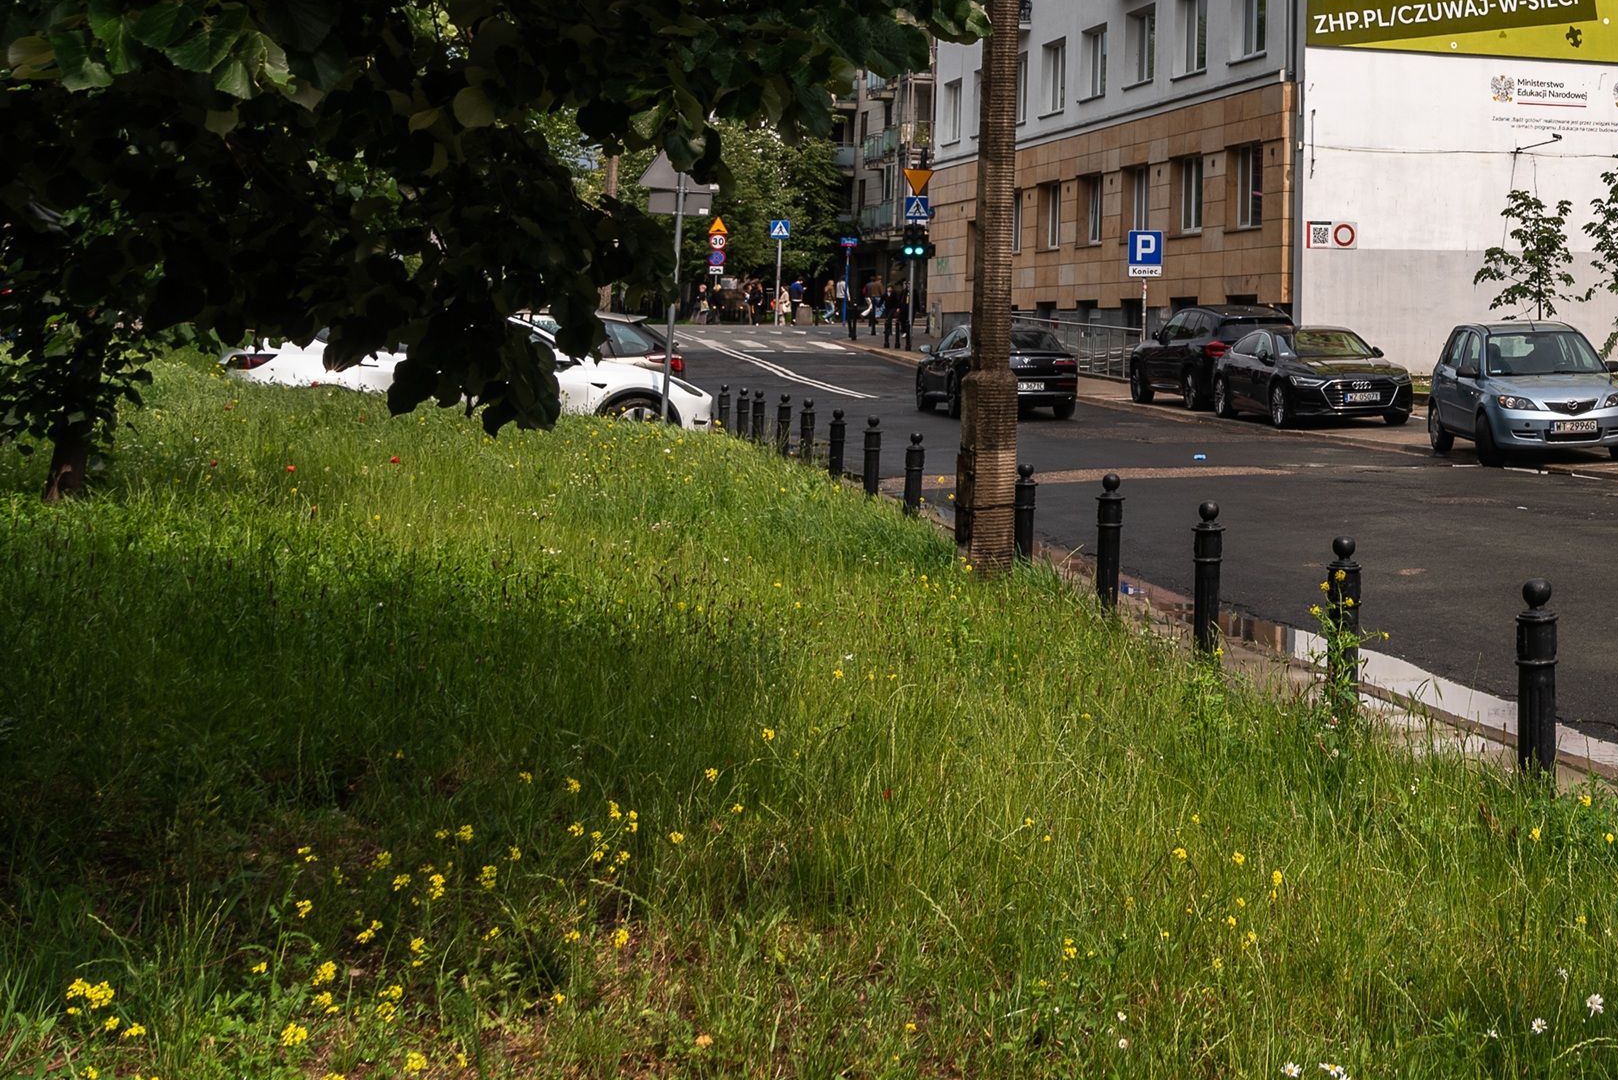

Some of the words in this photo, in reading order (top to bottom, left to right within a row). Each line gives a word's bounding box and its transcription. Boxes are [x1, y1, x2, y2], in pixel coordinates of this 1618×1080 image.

[1517, 78, 1565, 88] Ministerstwo
[1517, 88, 1547, 99] Edukacji
[1548, 91, 1588, 101] Narodowej
[712, 236, 724, 246] 30
[1136, 235, 1155, 261] P
[1132, 267, 1158, 275] Koniec
[1570, 421, 1596, 431] 2996G
